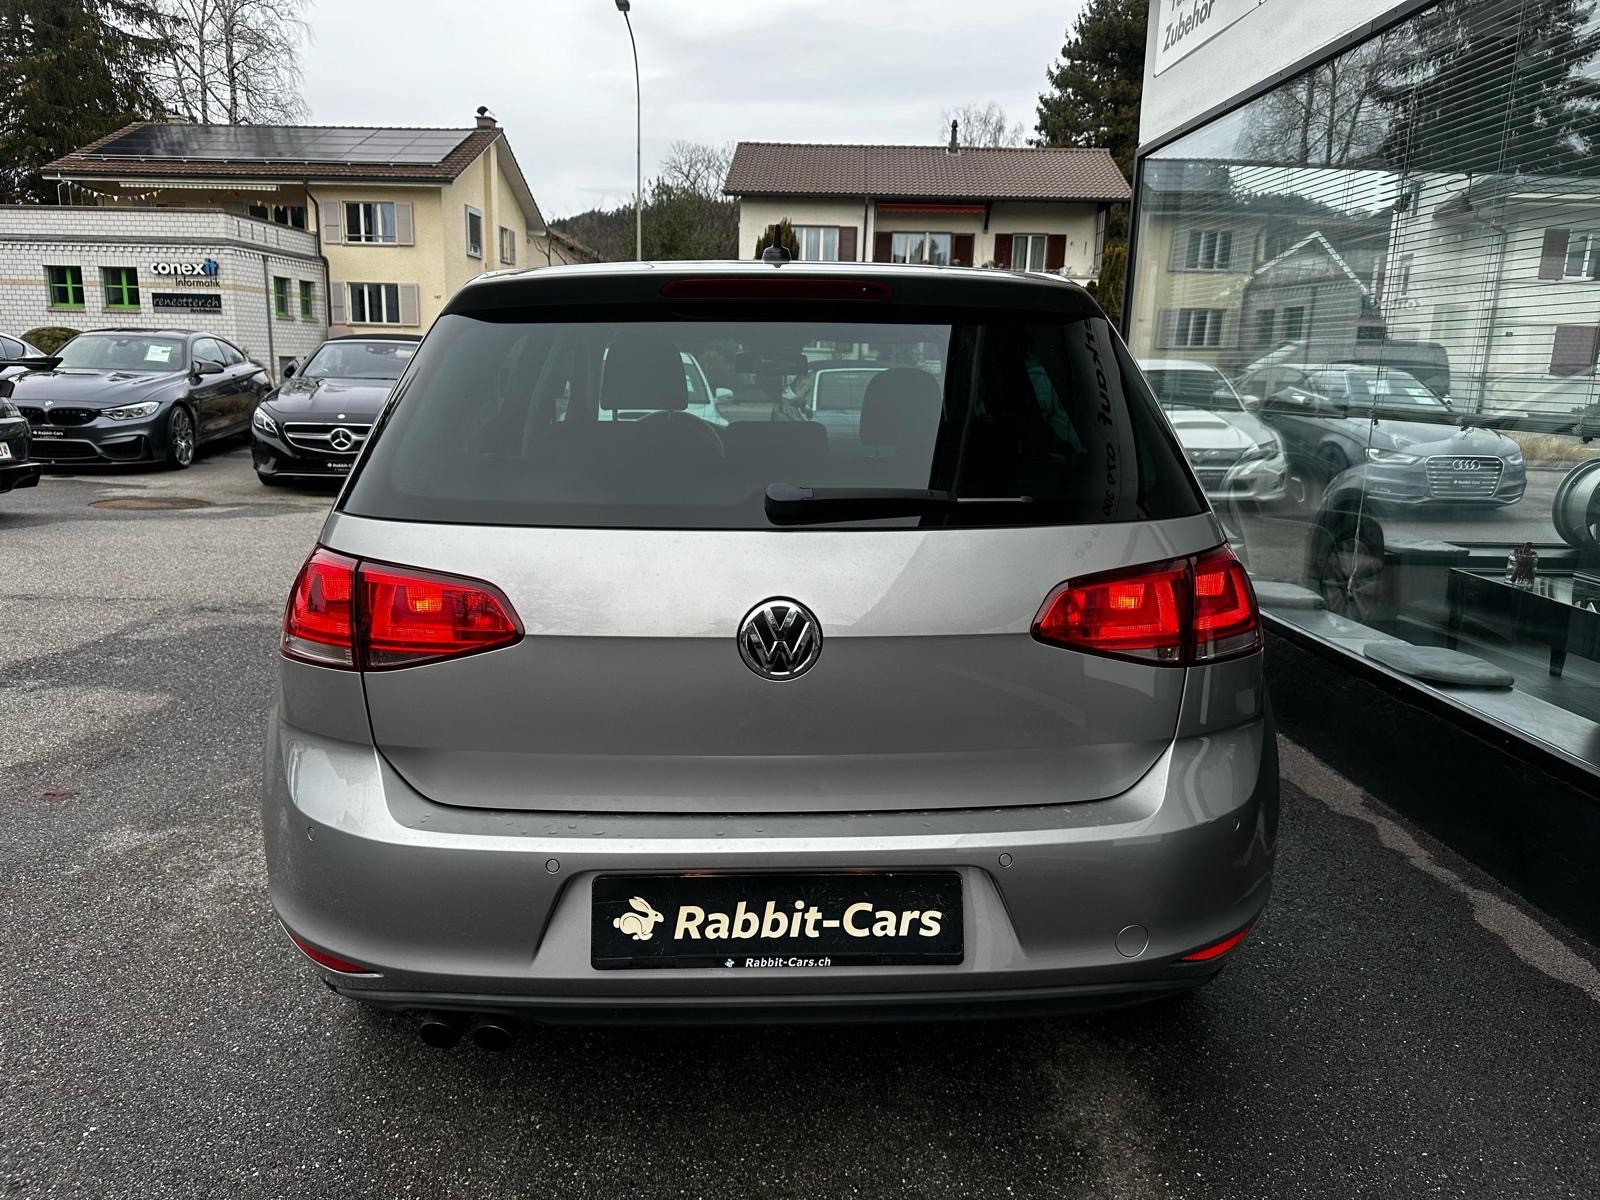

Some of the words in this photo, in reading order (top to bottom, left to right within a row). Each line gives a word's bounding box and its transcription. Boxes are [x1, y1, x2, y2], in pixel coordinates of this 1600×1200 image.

[150, 258, 218, 275] conexit
[175, 276, 220, 288] Informatik
[153, 296, 219, 307] reneotter.ch
[673, 900, 943, 940] Rabbit-Cars
[745, 957, 832, 968] Rabbit-Cars.ch
